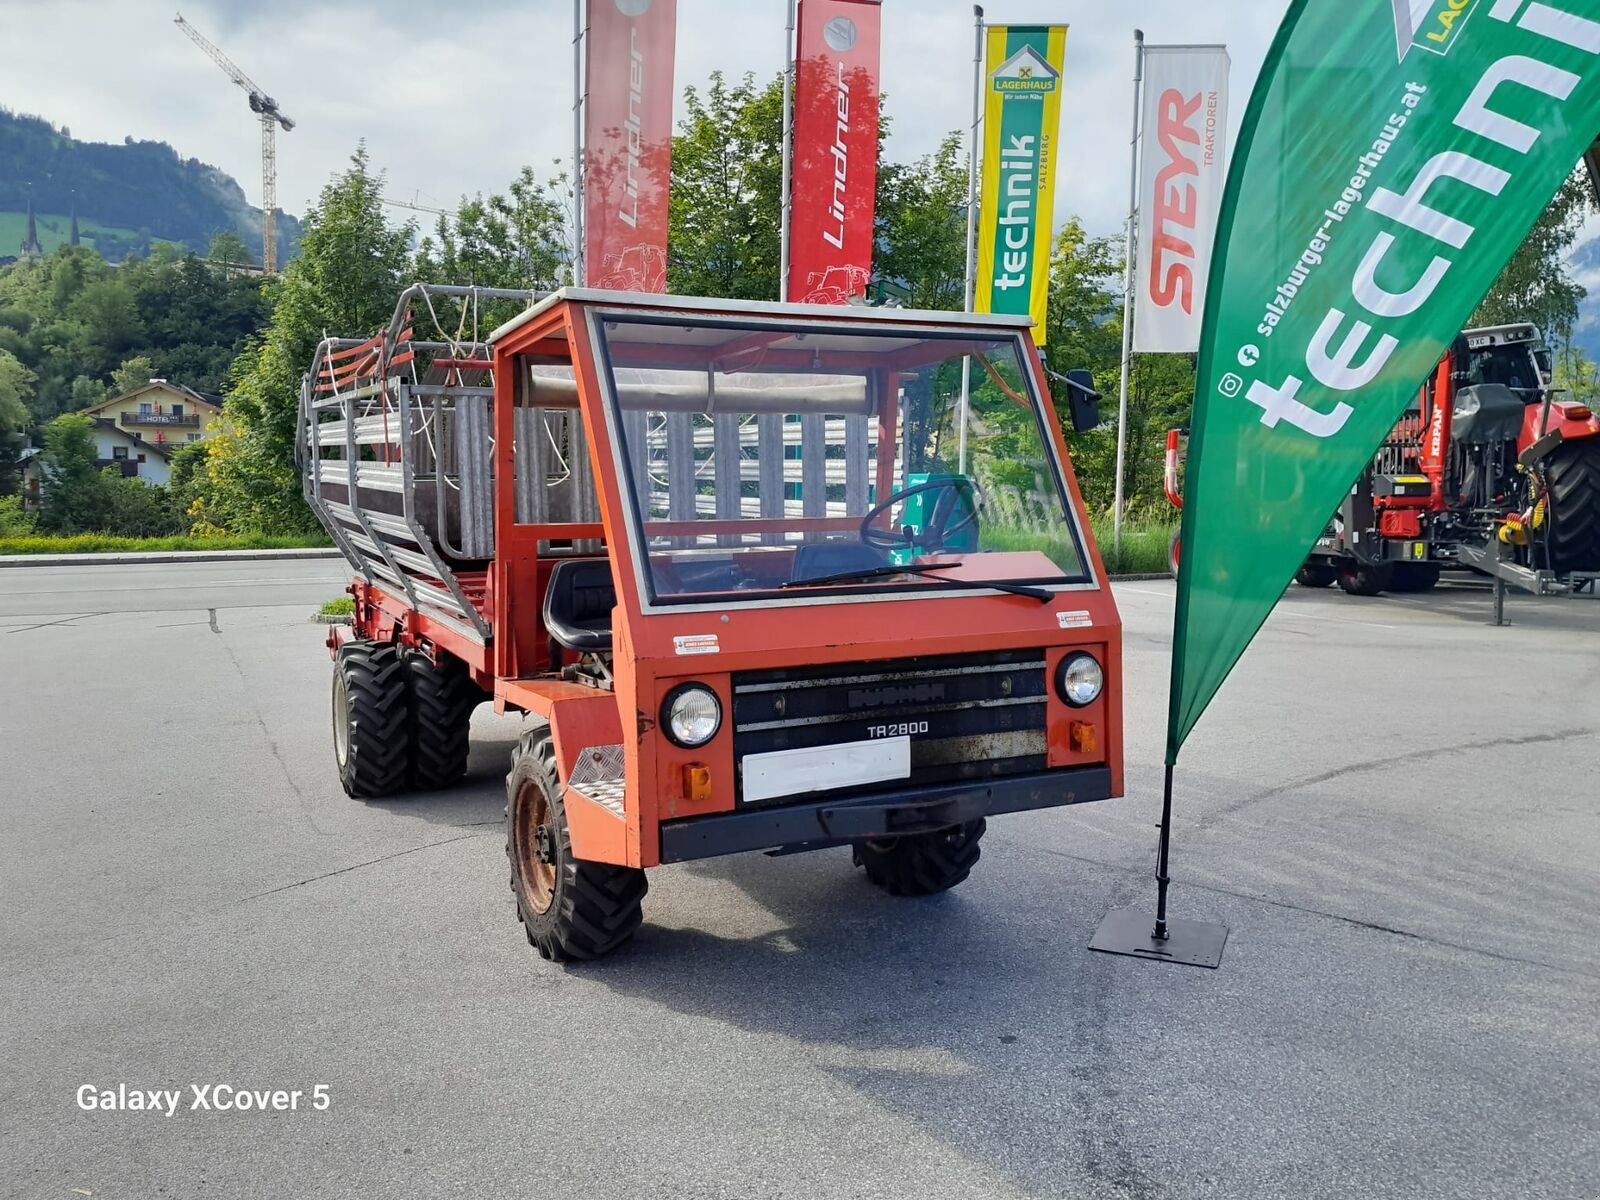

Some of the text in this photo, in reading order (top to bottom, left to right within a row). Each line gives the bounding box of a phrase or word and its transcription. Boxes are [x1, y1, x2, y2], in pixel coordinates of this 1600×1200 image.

[619, 27, 643, 229] Lindner
[996, 80, 1053, 90] LAGERHAUS
[1204, 91, 1218, 168] TRAKTOREN
[823, 61, 849, 250] Lindner
[994, 134, 1035, 291] technik
[1039, 134, 1050, 191] SALZBURG
[1150, 88, 1203, 316] STEYR
[1256, 80, 1427, 338] salzburger-lagerhaus.at
[146, 415, 170, 423] HOTEL
[1431, 408, 1443, 457] KRPAN
